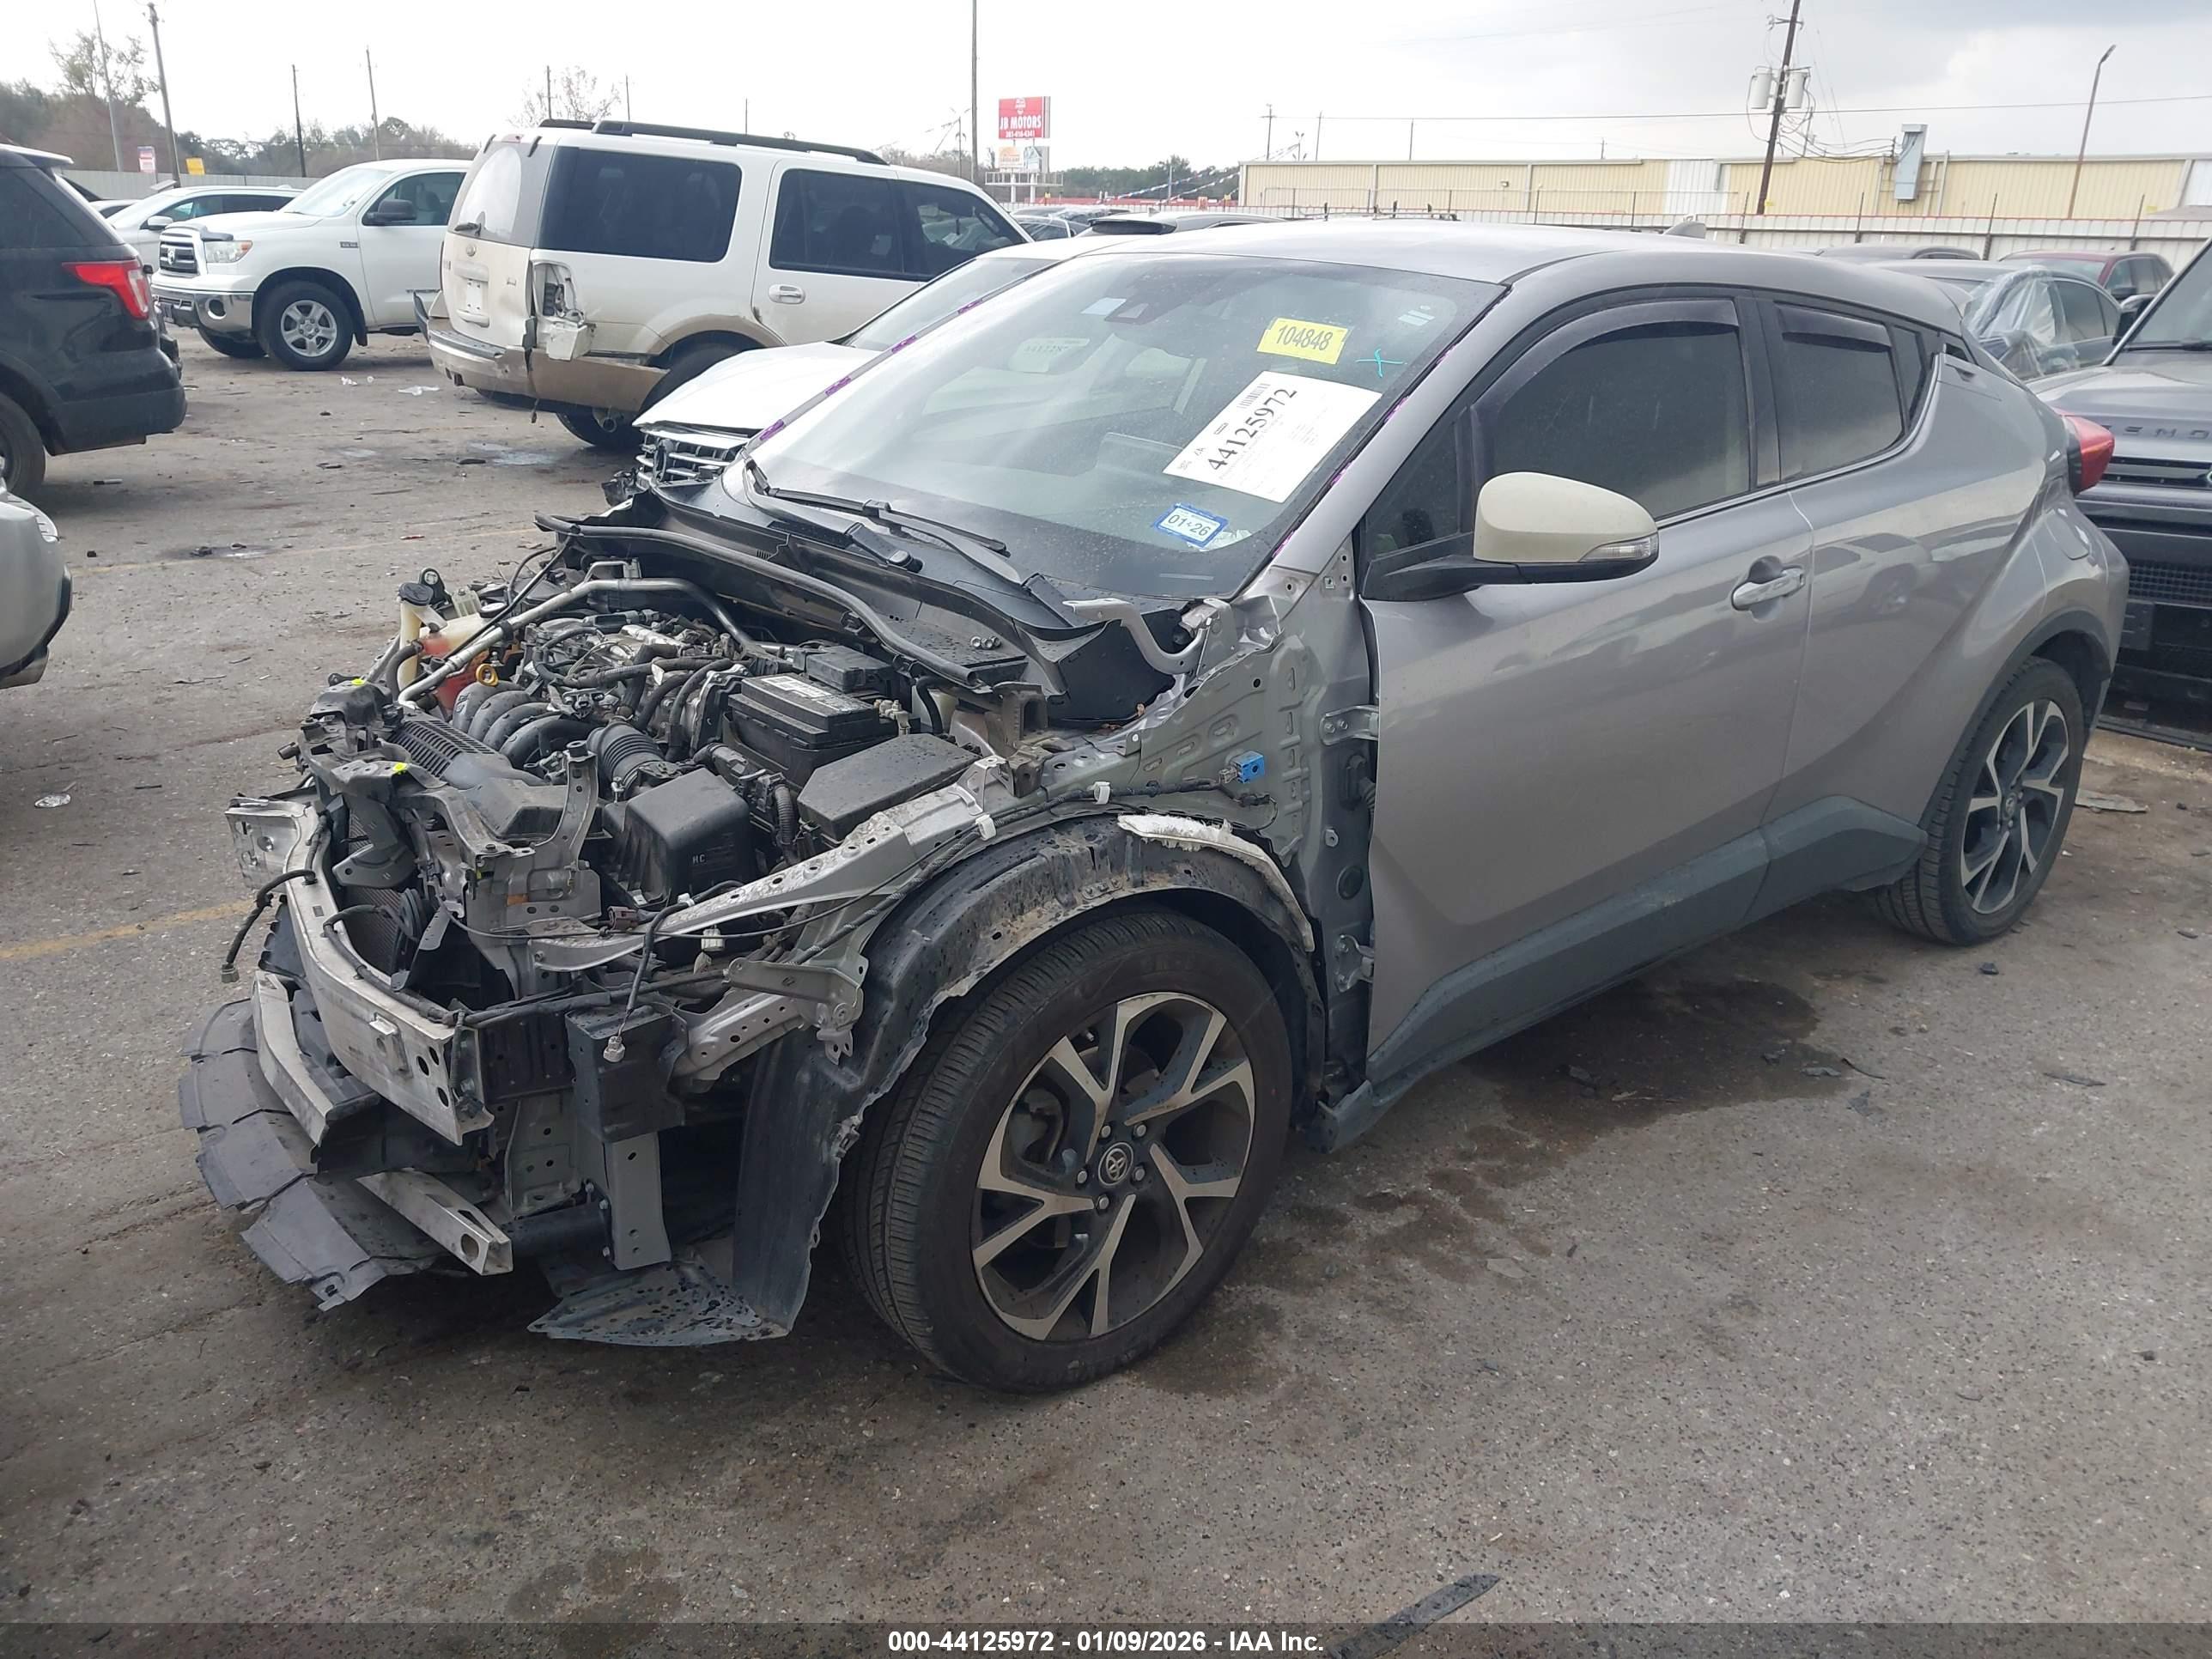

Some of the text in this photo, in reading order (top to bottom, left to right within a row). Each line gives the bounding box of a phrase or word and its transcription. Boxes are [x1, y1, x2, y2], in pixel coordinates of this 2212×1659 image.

[1000, 114, 1042, 131] JB MOTORS
[1275, 325, 1334, 350] 104848
[1206, 387, 1298, 471] 44125972
